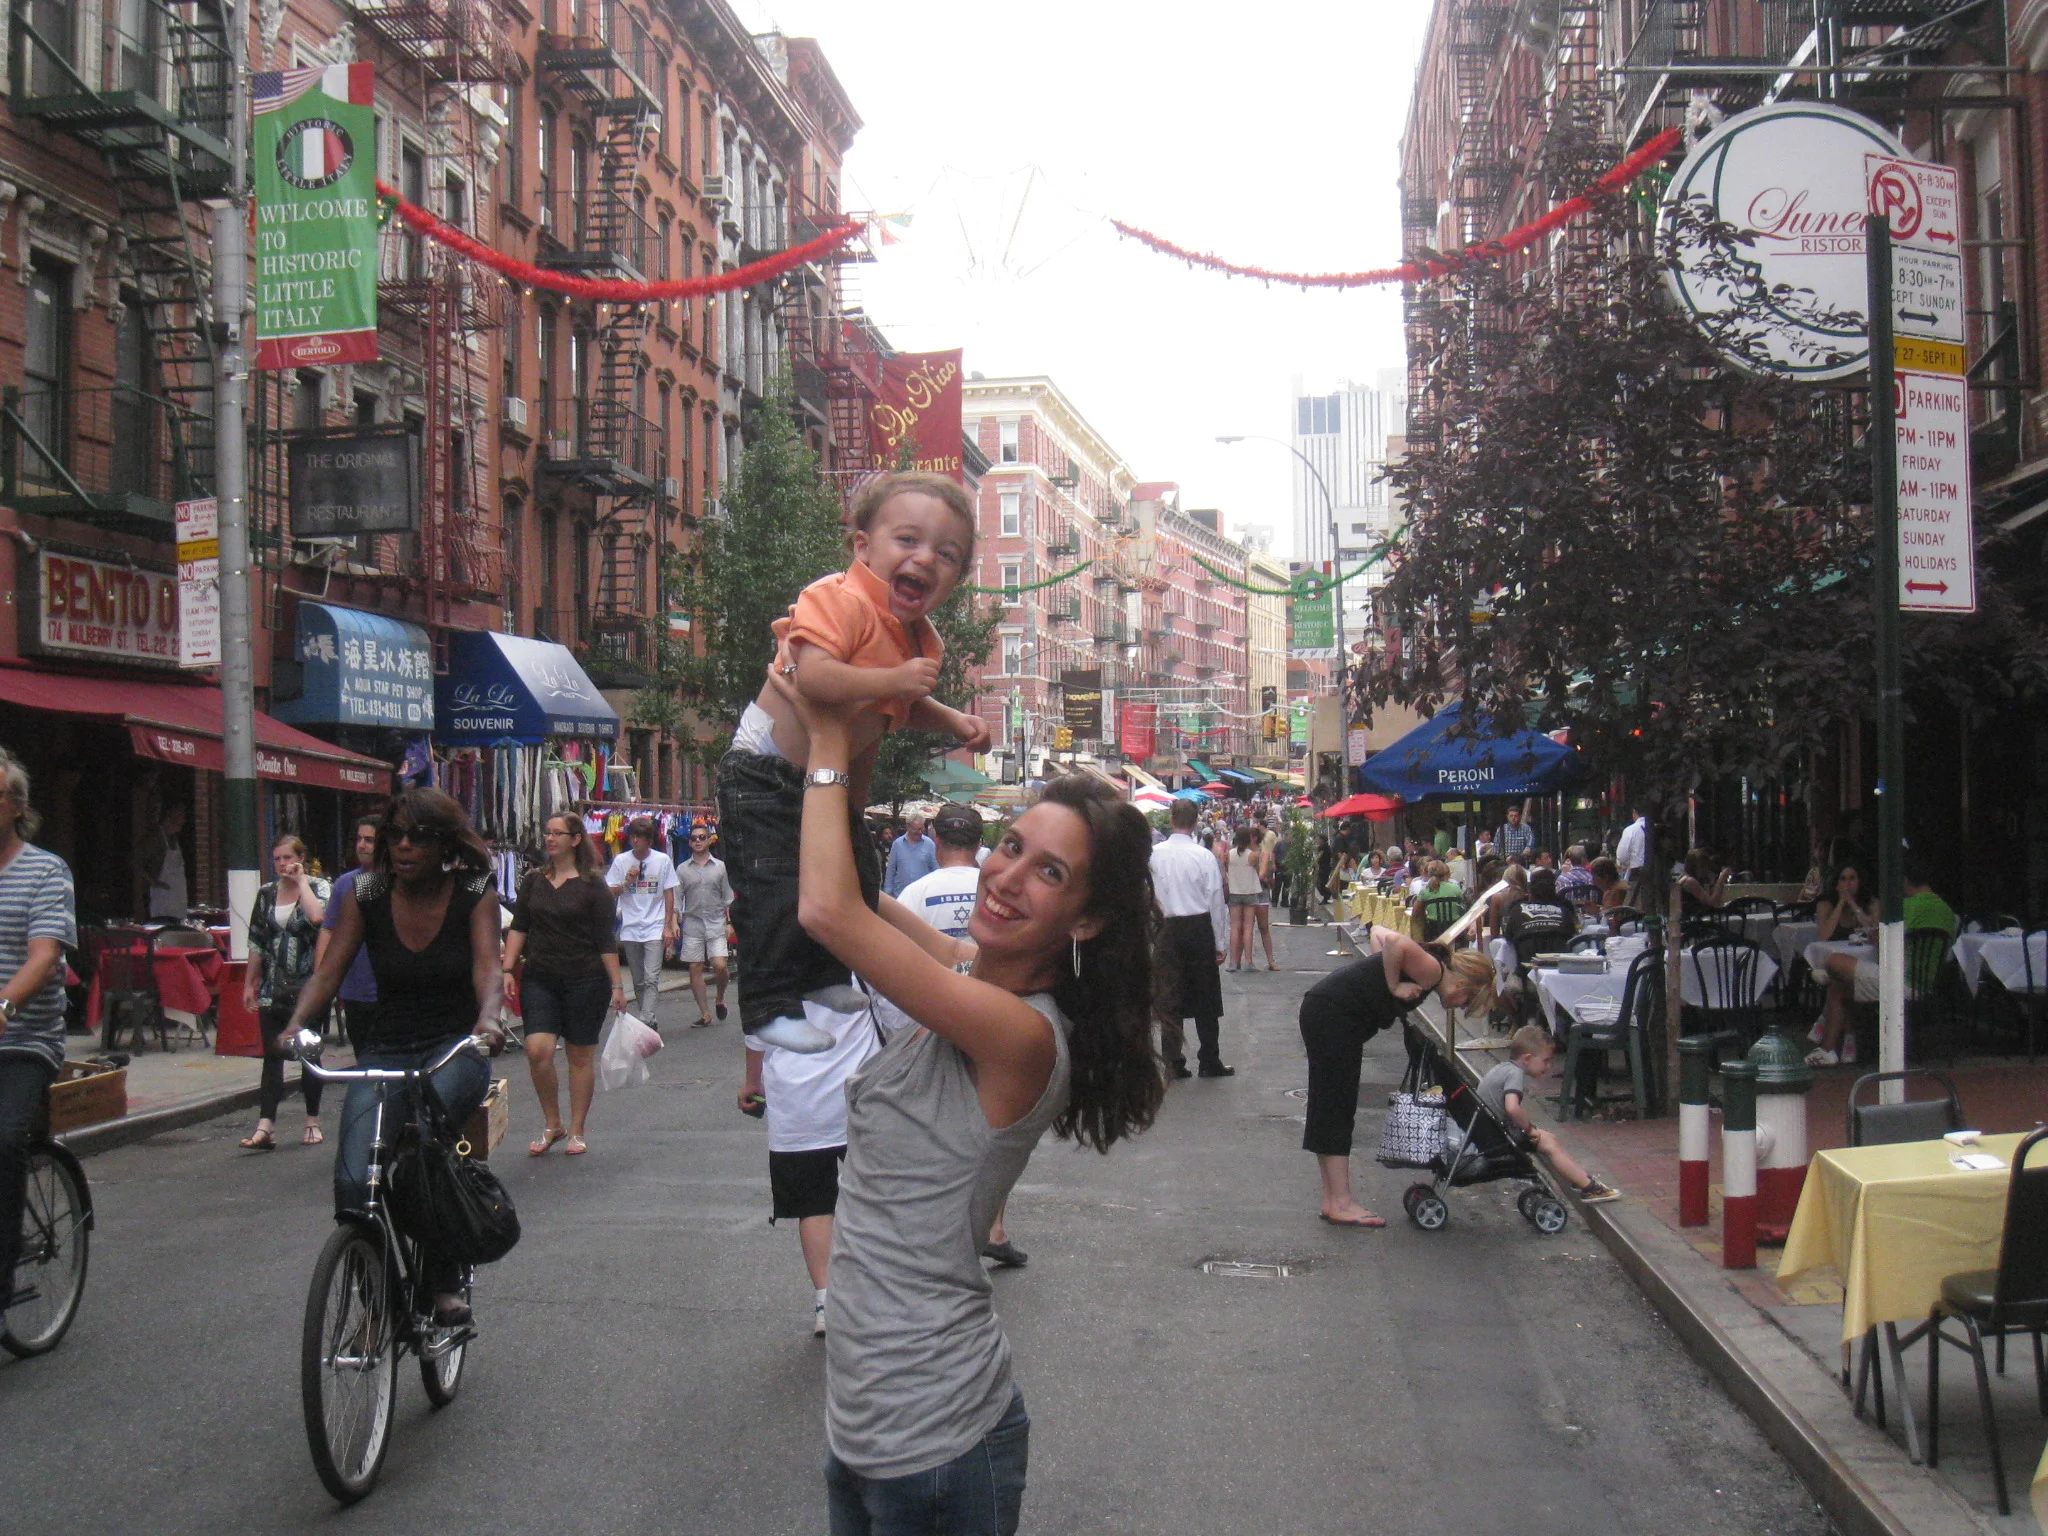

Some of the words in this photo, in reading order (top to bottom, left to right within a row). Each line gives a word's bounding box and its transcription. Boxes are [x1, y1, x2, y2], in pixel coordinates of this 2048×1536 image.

[286, 120, 344, 139] HISTORIC
[277, 158, 316, 189] LITTLE
[322, 152, 352, 186] ITALY
[1925, 195, 1952, 208] EXCEPT
[260, 199, 369, 225] WELCOME
[1747, 187, 1866, 241] Lune
[1932, 209, 1947, 220] SUN
[262, 231, 287, 251] TO
[1801, 238, 1863, 252] RISTOR
[262, 248, 362, 276] HISTORIC
[1898, 255, 1919, 265] HOUR
[1922, 260, 1954, 272] PARKING
[263, 278, 336, 303] LITTLE
[1891, 288, 1914, 305] CEPT
[1919, 293, 1956, 311] SUNDAY
[263, 306, 324, 329] ITALY
[296, 345, 337, 357] BERTOLLI
[1902, 347, 1915, 361] 27
[1922, 349, 1946, 365] SEPT
[1949, 353, 1957, 367] 11
[870, 403, 919, 447] Da
[905, 359, 957, 409] Nico
[1908, 389, 1962, 413] PARKING
[1897, 426, 1916, 446] PM
[1927, 429, 1956, 449] 11PM
[305, 453, 333, 469] THE
[1902, 454, 1942, 472] FRIDAY
[1899, 479, 1919, 498] AM
[1929, 481, 1958, 500] 11PM
[177, 504, 191, 521] NO
[1897, 506, 1951, 524] SATURDAY
[1903, 531, 1946, 548] SUNDAY
[179, 562, 194, 580] NO
[1904, 555, 1957, 571] HOLIDAYS
[46, 556, 149, 629] BENITO
[68, 622, 113, 648] MULBERRY
[374, 680, 390, 695] STAR
[392, 683, 404, 698] PET
[406, 685, 423, 700] SHOP
[454, 718, 514, 731] SOUVENIR
[1438, 767, 1496, 784] PERONI
[1453, 783, 1481, 791] ITALY
[940, 894, 977, 903] ISRAE
